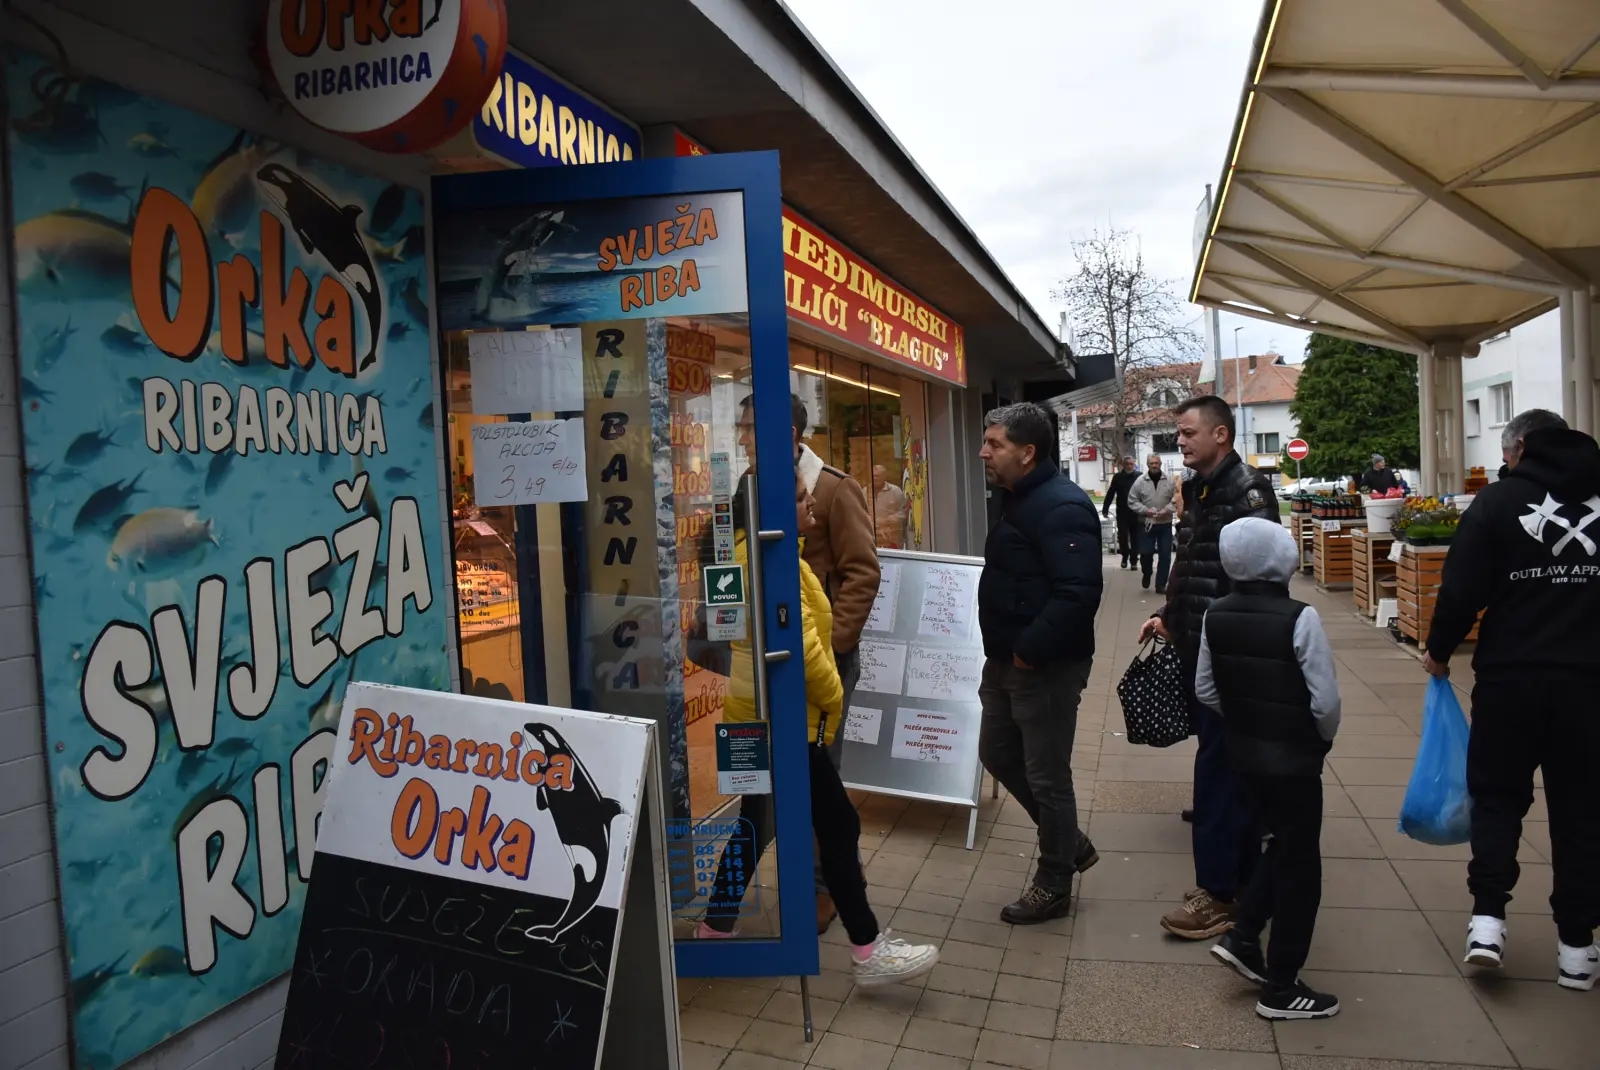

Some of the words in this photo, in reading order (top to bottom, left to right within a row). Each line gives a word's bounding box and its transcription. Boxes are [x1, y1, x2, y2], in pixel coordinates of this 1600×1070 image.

[294, 52, 432, 99] RIBARNICA
[598, 202, 718, 273] SVJEŽA
[130, 187, 358, 379] Orka
[620, 259, 701, 312] RIBA
[143, 376, 387, 457] RIBARNICA
[499, 442, 557, 459] AKCIJA
[1509, 565, 1568, 580] OUTLAW
[80, 472, 432, 800] SVJEŽA
[348, 708, 574, 791] Ribarnica
[388, 777, 535, 880] Orka
[694, 823, 742, 836] VRIJEME
[696, 844, 742, 856] 08-13
[696, 858, 743, 869] 07-14
[697, 871, 745, 882] 07-15
[698, 885, 745, 897] 07-13
